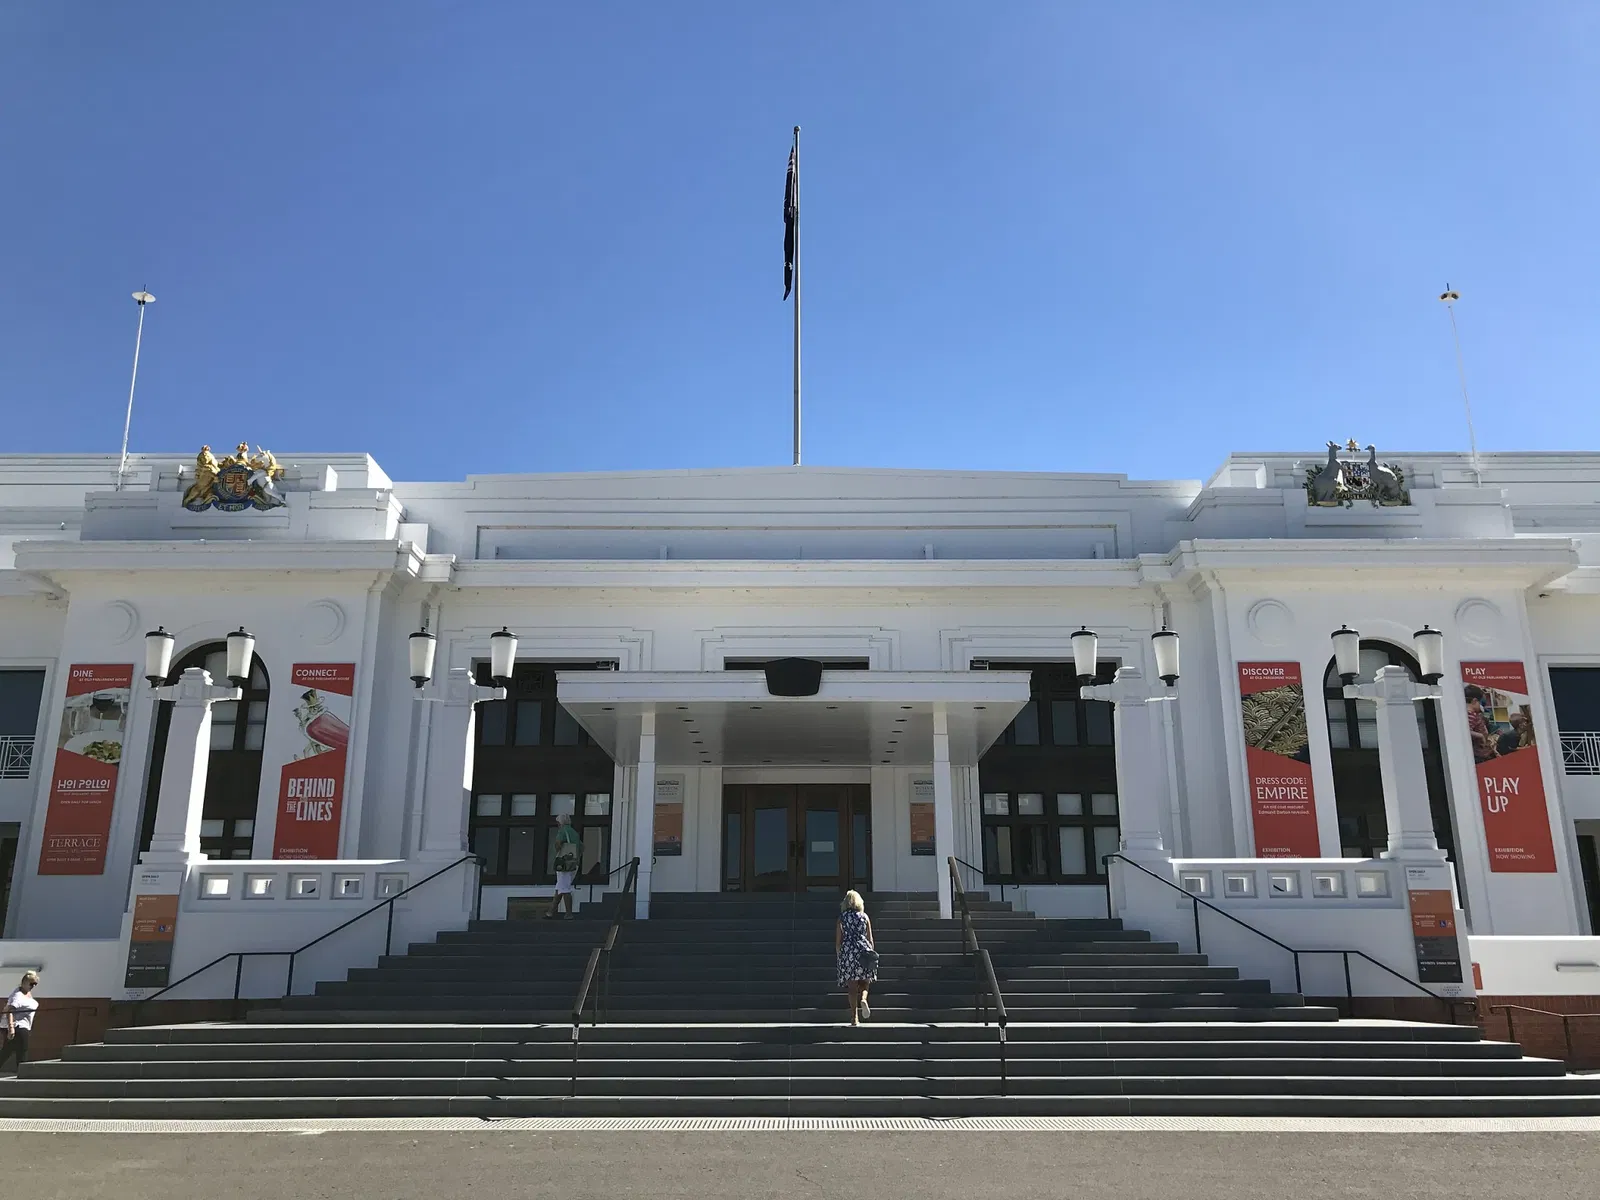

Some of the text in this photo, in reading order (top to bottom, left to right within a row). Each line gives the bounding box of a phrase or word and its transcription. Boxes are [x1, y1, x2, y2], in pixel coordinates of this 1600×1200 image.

[73, 669, 93, 678] DINE
[295, 669, 337, 677] CONNECT
[1242, 668, 1285, 676] DISCOVER
[1464, 667, 1486, 675] PLAY
[58, 780, 110, 789] HOI POLLOI
[1256, 777, 1280, 785] DRESS
[288, 778, 336, 798] BEHIND
[1484, 777, 1520, 795] PLAY
[1256, 786, 1308, 800] EMPIRE
[1488, 796, 1508, 813] UP
[296, 801, 333, 821] LINES
[50, 838, 101, 848] TERRACE
